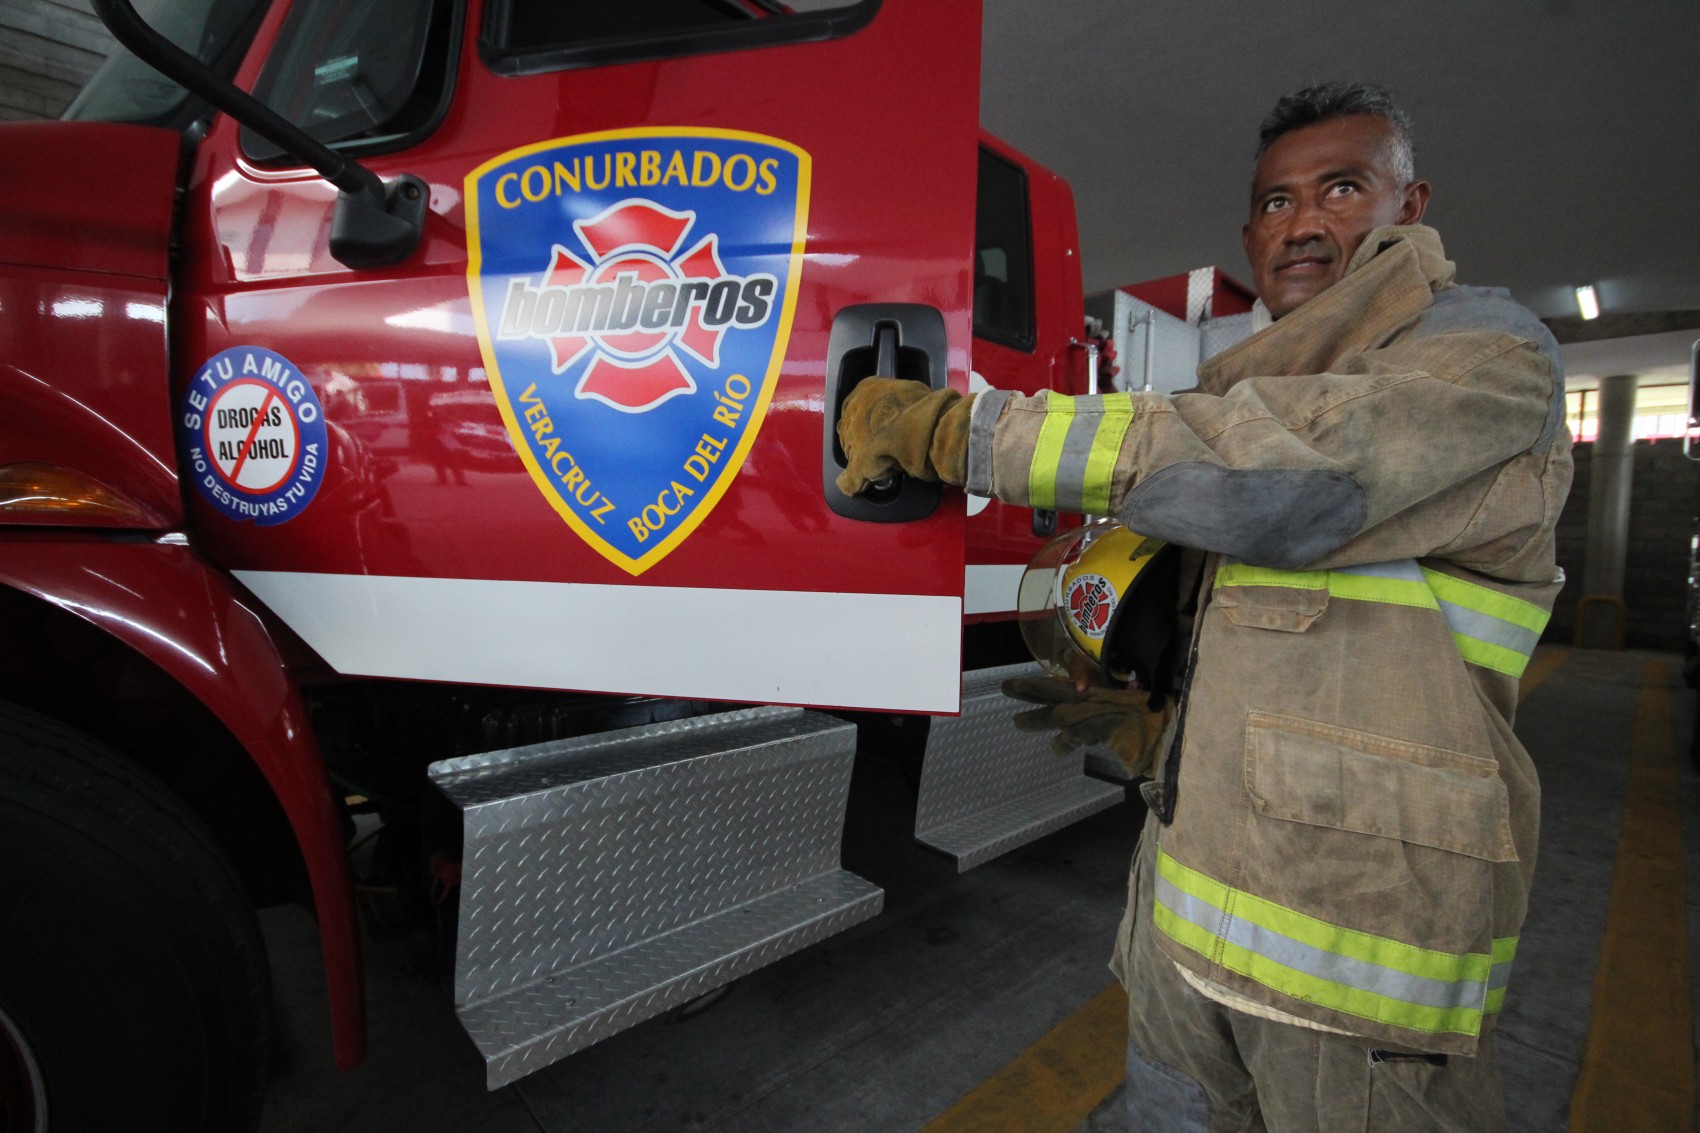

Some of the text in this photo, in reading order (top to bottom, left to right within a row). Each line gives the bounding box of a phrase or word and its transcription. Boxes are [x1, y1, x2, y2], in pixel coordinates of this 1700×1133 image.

[495, 150, 779, 209] CONURBADOS
[501, 271, 775, 336] bomberos
[184, 353, 317, 430] SE TU AMIGO
[217, 406, 281, 429] DROGAS
[190, 443, 318, 517] NO DESTRUYAS TU VIDA
[518, 383, 616, 525] VERACRUZ
[626, 373, 751, 543] BOCA DEL RÍO
[1078, 577, 1107, 635] bomberos
